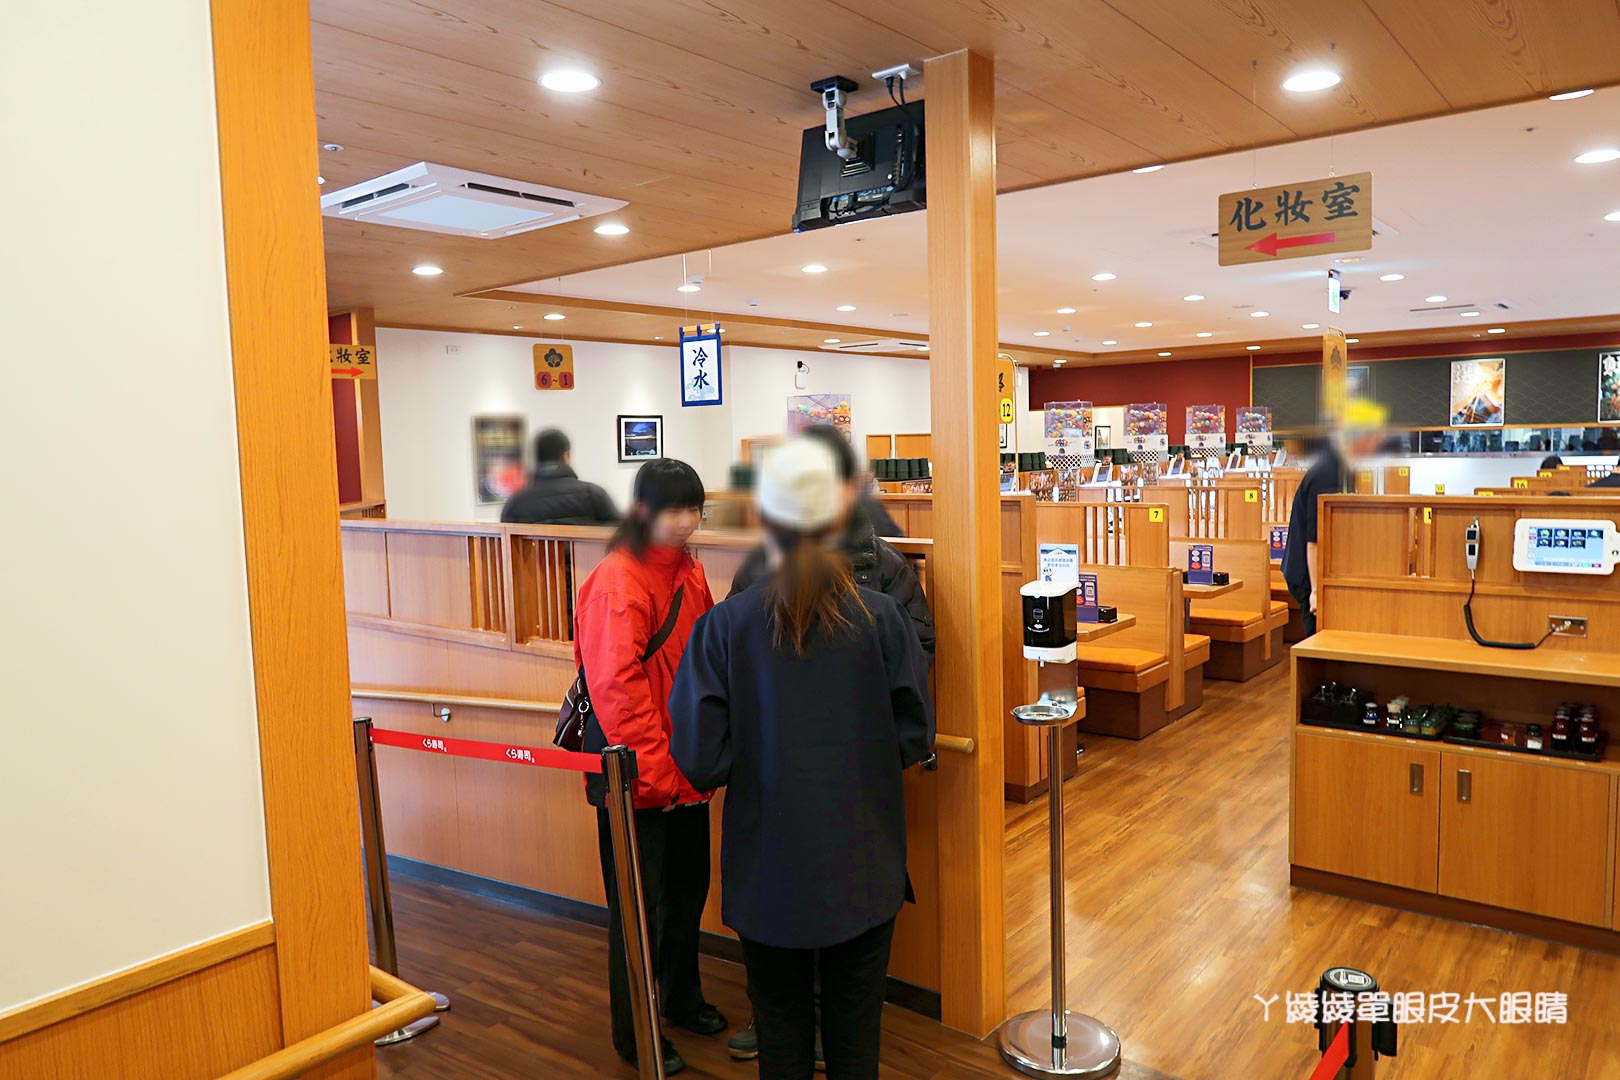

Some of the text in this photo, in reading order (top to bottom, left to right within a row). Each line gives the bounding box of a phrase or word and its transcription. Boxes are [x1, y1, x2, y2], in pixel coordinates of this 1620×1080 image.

[1229, 182, 1360, 232] 化妝室
[330, 347, 371, 365] 妝室
[692, 347, 710, 390] 冷水
[1002, 403, 1011, 417] 12
[1248, 492, 1254, 500] 8
[1153, 510, 1160, 519] 7
